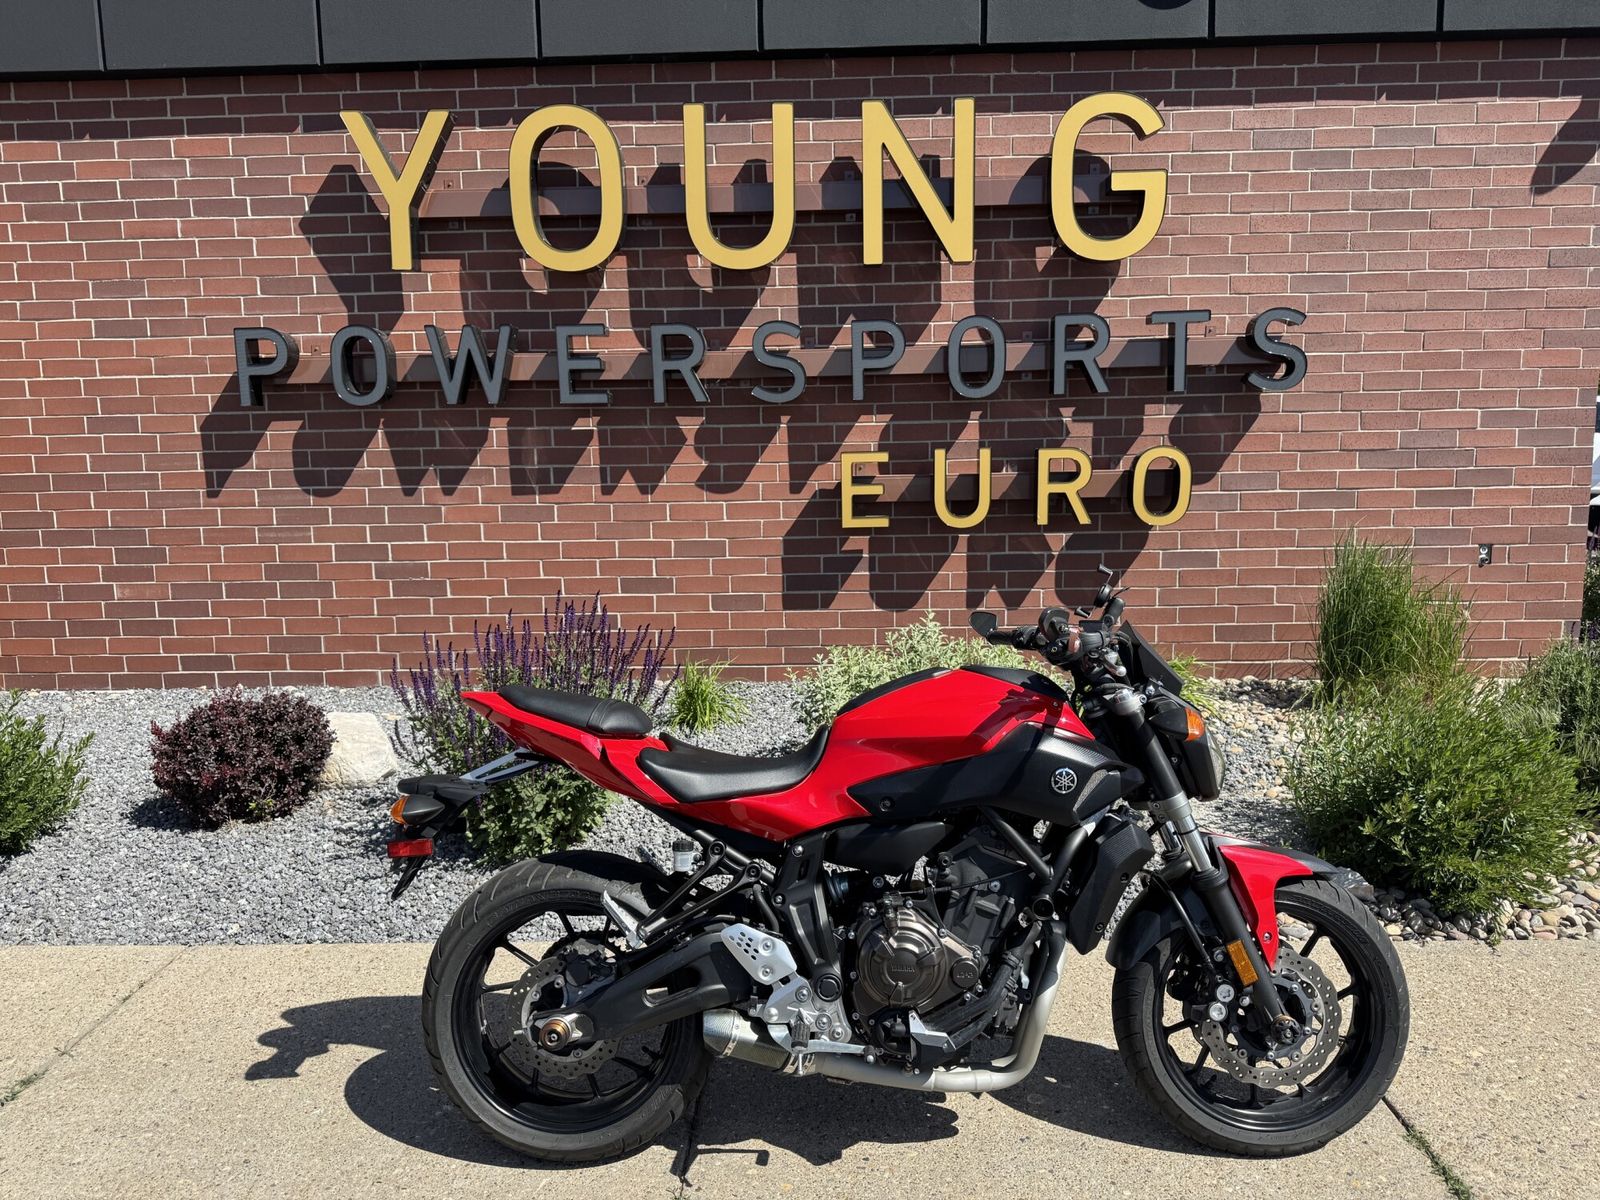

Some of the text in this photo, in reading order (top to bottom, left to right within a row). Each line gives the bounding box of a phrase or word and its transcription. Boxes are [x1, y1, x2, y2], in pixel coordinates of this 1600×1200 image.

[340, 91, 1168, 273] YOUNG
[233, 308, 1308, 408] POWERSPORTS
[839, 446, 1193, 529] EURO
